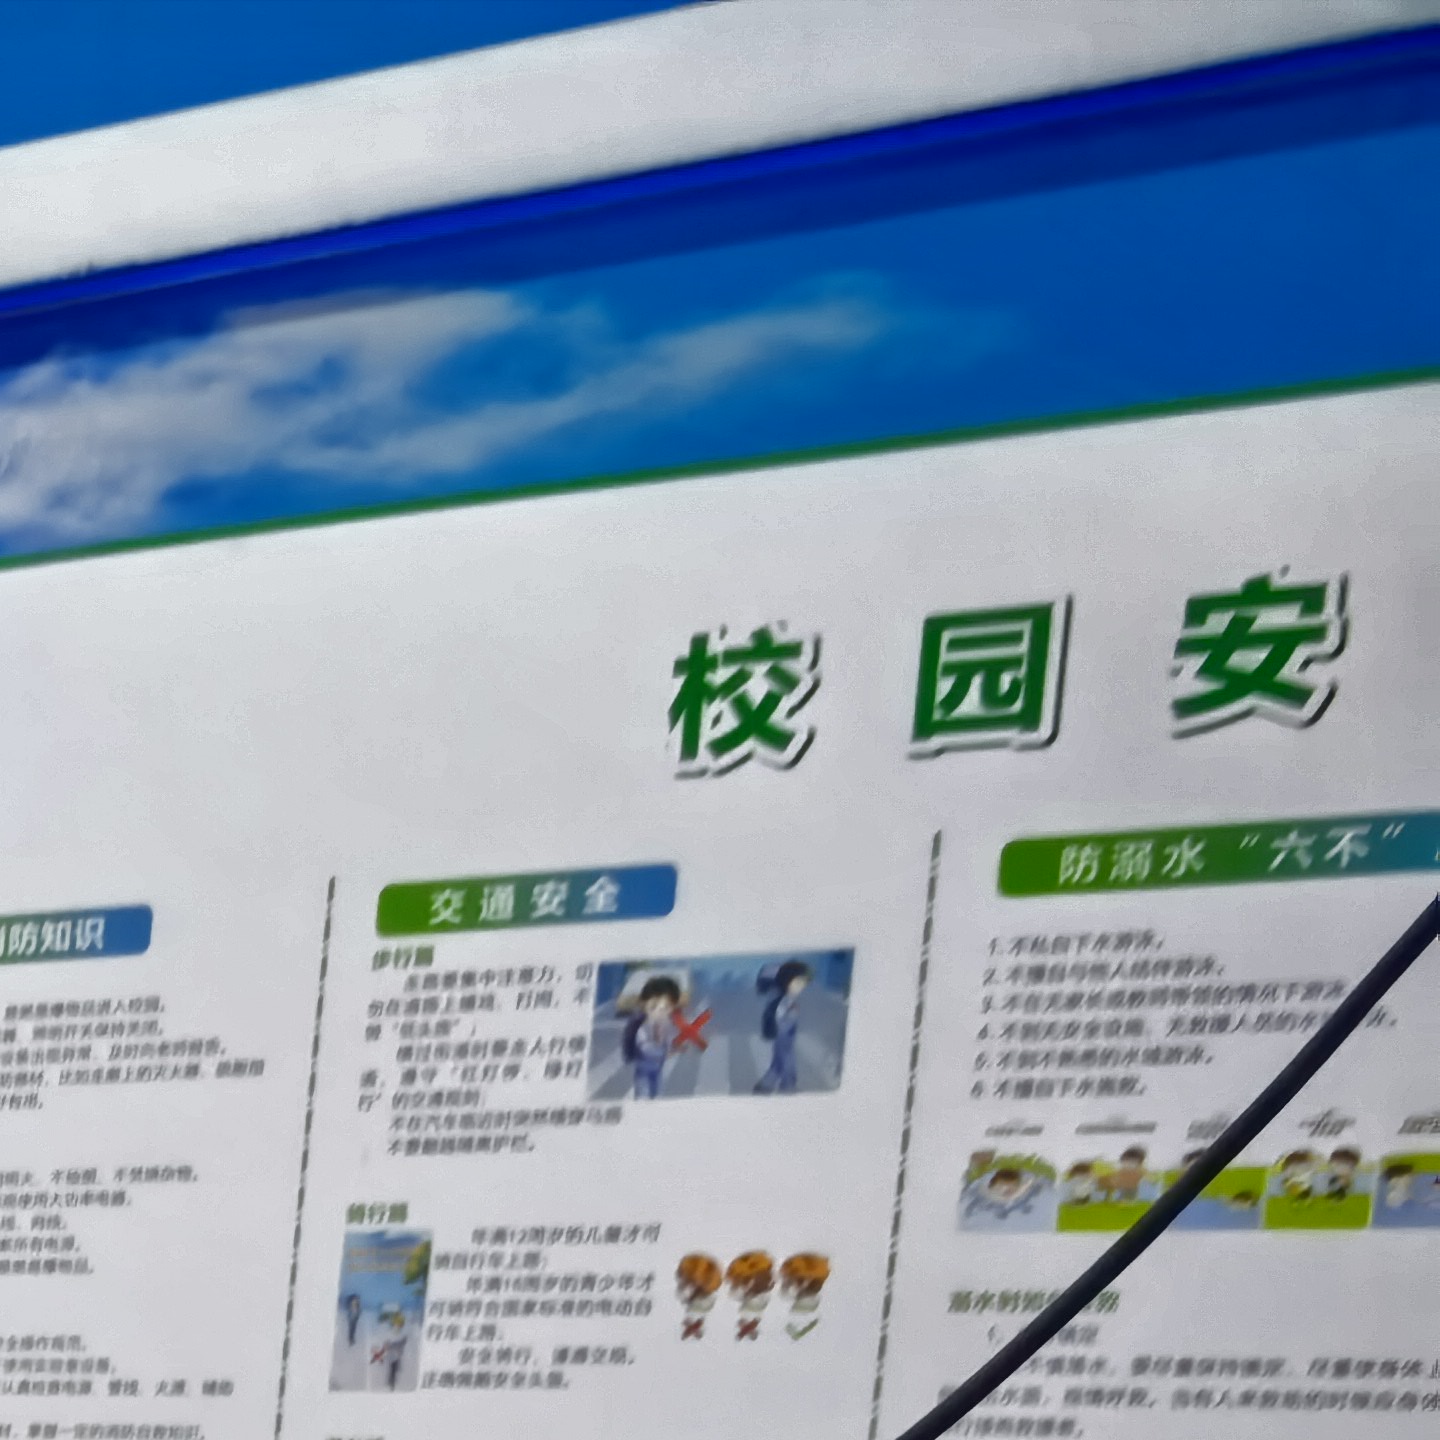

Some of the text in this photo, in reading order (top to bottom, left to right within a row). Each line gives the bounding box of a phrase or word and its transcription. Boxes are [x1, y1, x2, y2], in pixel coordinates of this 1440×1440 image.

[667, 567, 1350, 777] 校园安
[430, 875, 620, 926] 交通安全
